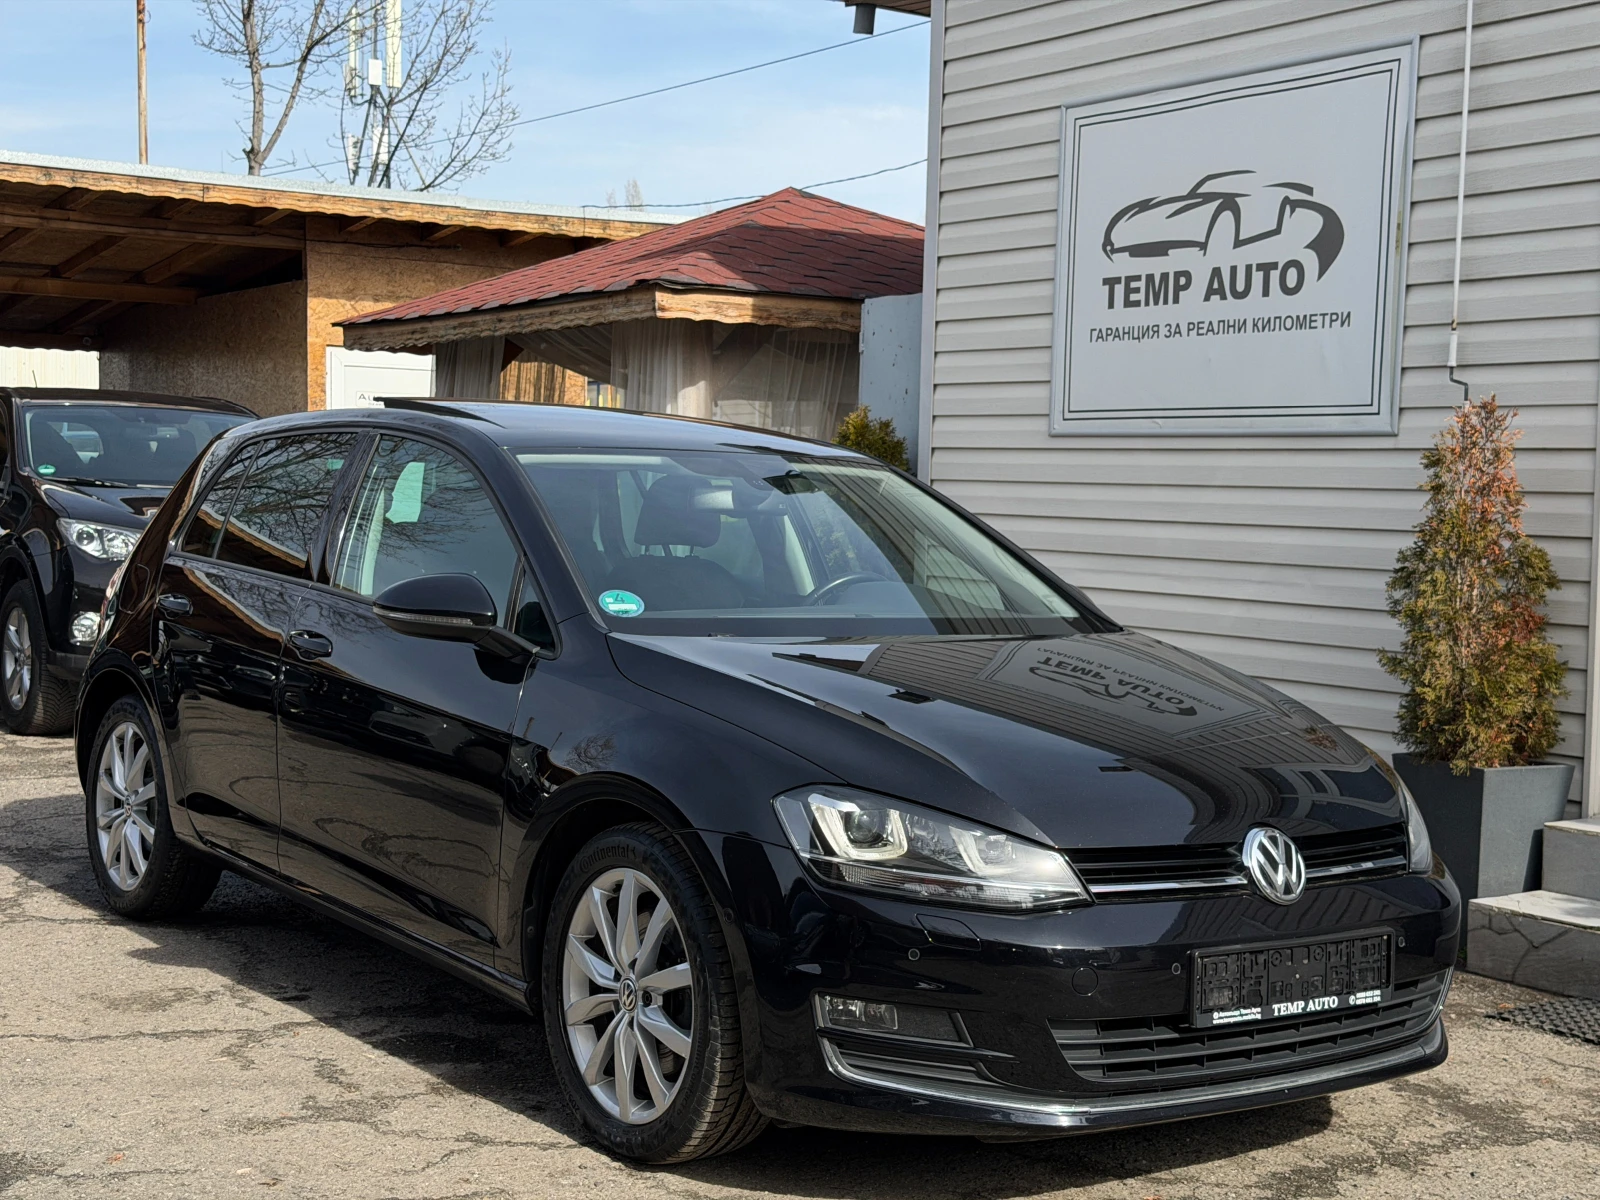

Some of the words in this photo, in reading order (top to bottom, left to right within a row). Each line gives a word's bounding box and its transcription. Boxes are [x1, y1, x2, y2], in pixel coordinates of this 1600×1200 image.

[1102, 269, 1192, 310] TEMP
[1203, 258, 1306, 302] AUTO
[1089, 324, 1160, 343] ГАРАНЦИЯ
[1164, 322, 1183, 338] ЗА
[1186, 318, 1248, 337] РЕАЛНИ
[1252, 311, 1352, 334] КИЛОМЕТРИ
[579, 844, 630, 873] Continental
[1272, 1001, 1305, 1016] TEMP
[1306, 996, 1339, 1011] AUTO
